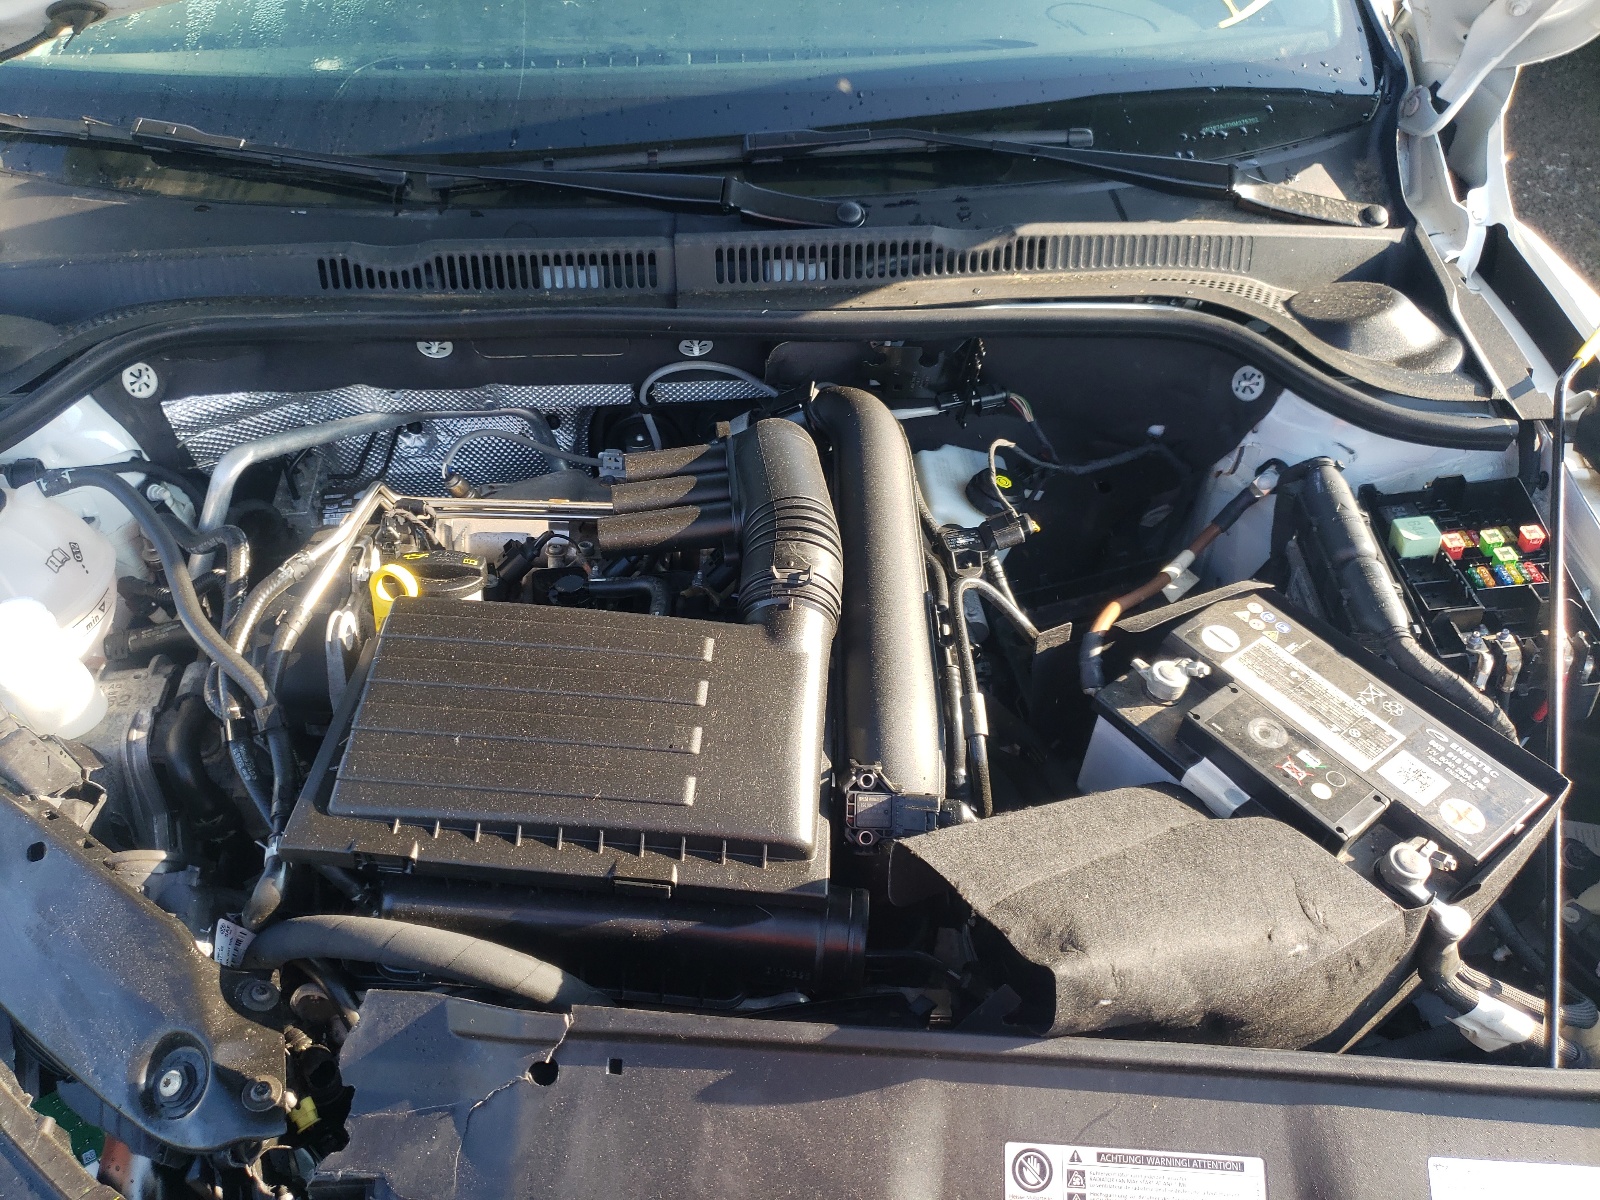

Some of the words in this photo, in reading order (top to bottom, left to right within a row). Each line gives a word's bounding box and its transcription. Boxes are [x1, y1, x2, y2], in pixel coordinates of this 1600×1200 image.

[85, 614, 100, 631] min
[1424, 746, 1439, 756] 12V
[1450, 742, 1499, 778] ENERTEC
[1100, 1153, 1144, 1164] ACHTUNG!
[1146, 1156, 1190, 1168] WARNING!
[1192, 1159, 1241, 1171] ATTENTION!
